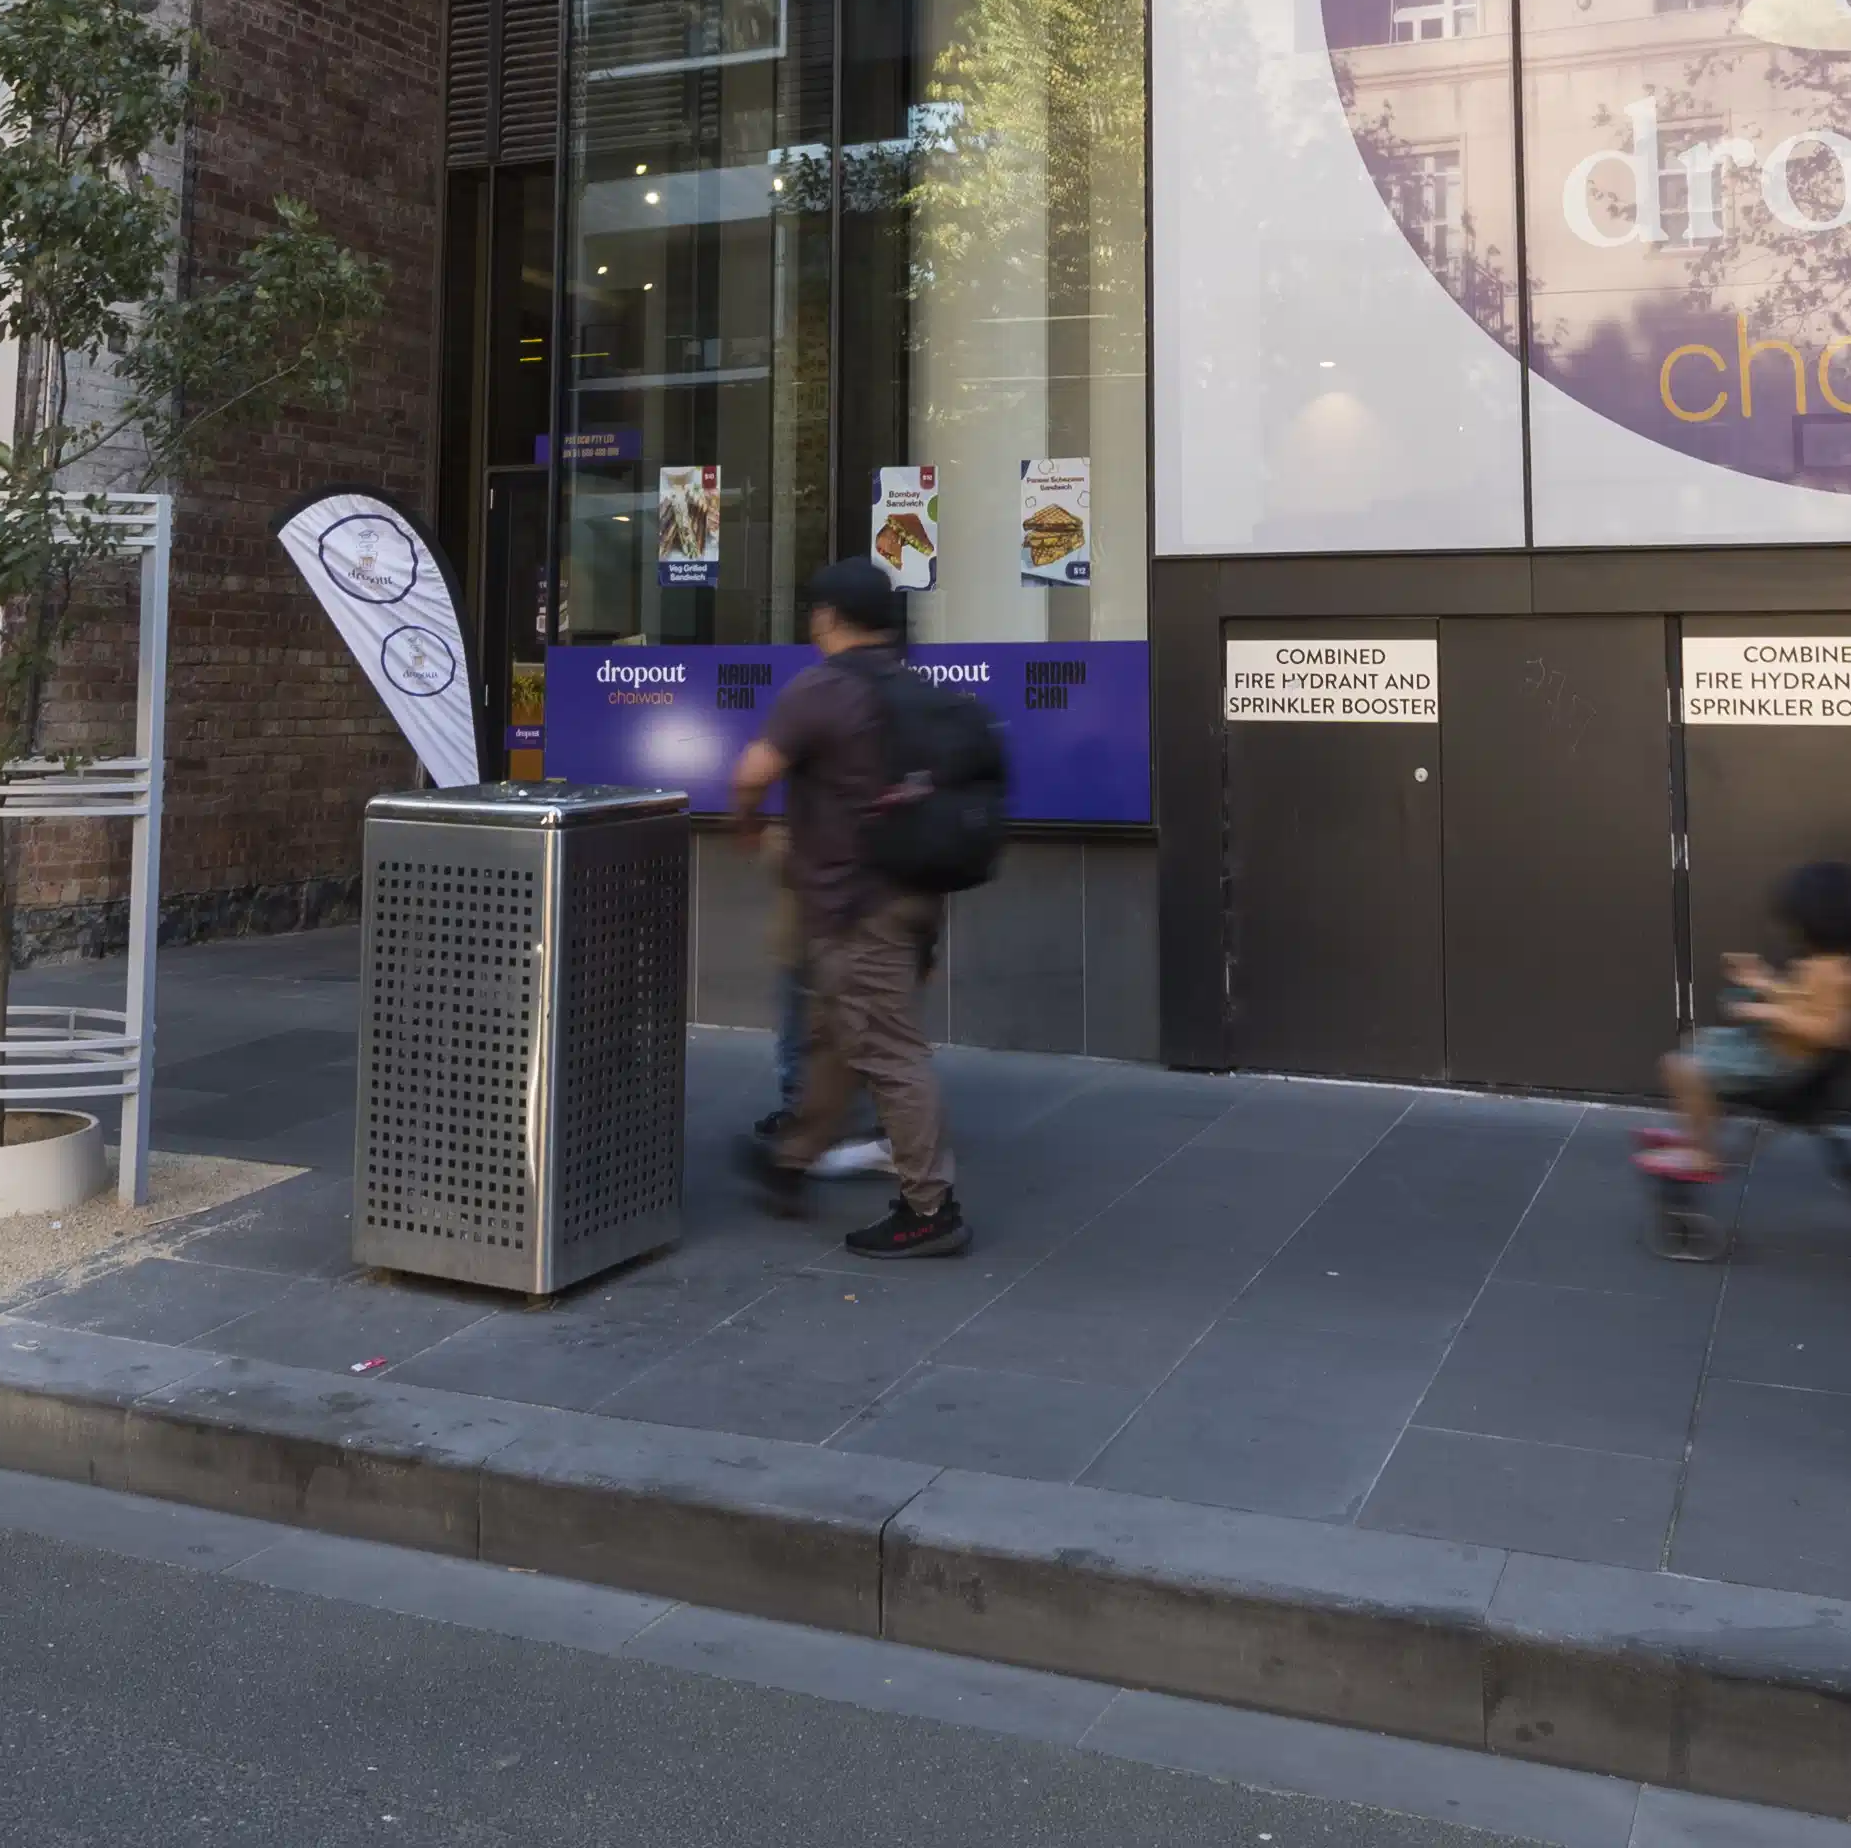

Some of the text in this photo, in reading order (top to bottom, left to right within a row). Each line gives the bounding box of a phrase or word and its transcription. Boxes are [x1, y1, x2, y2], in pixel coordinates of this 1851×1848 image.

[886, 499, 924, 508] Sandwich
[888, 491, 920, 499] Bombay
[670, 573, 706, 582] Sandwich
[1276, 648, 1386, 665] COMBINED
[596, 659, 687, 689] dropout
[900, 658, 991, 689] opout
[1235, 672, 1431, 690] FIRE HYDRANT AND
[1695, 672, 1743, 689] FIRE
[608, 689, 674, 705] chaiwala
[1229, 697, 1437, 715] SPRINKLER BOOSTER
[1690, 698, 1813, 716] SPRINKLER
